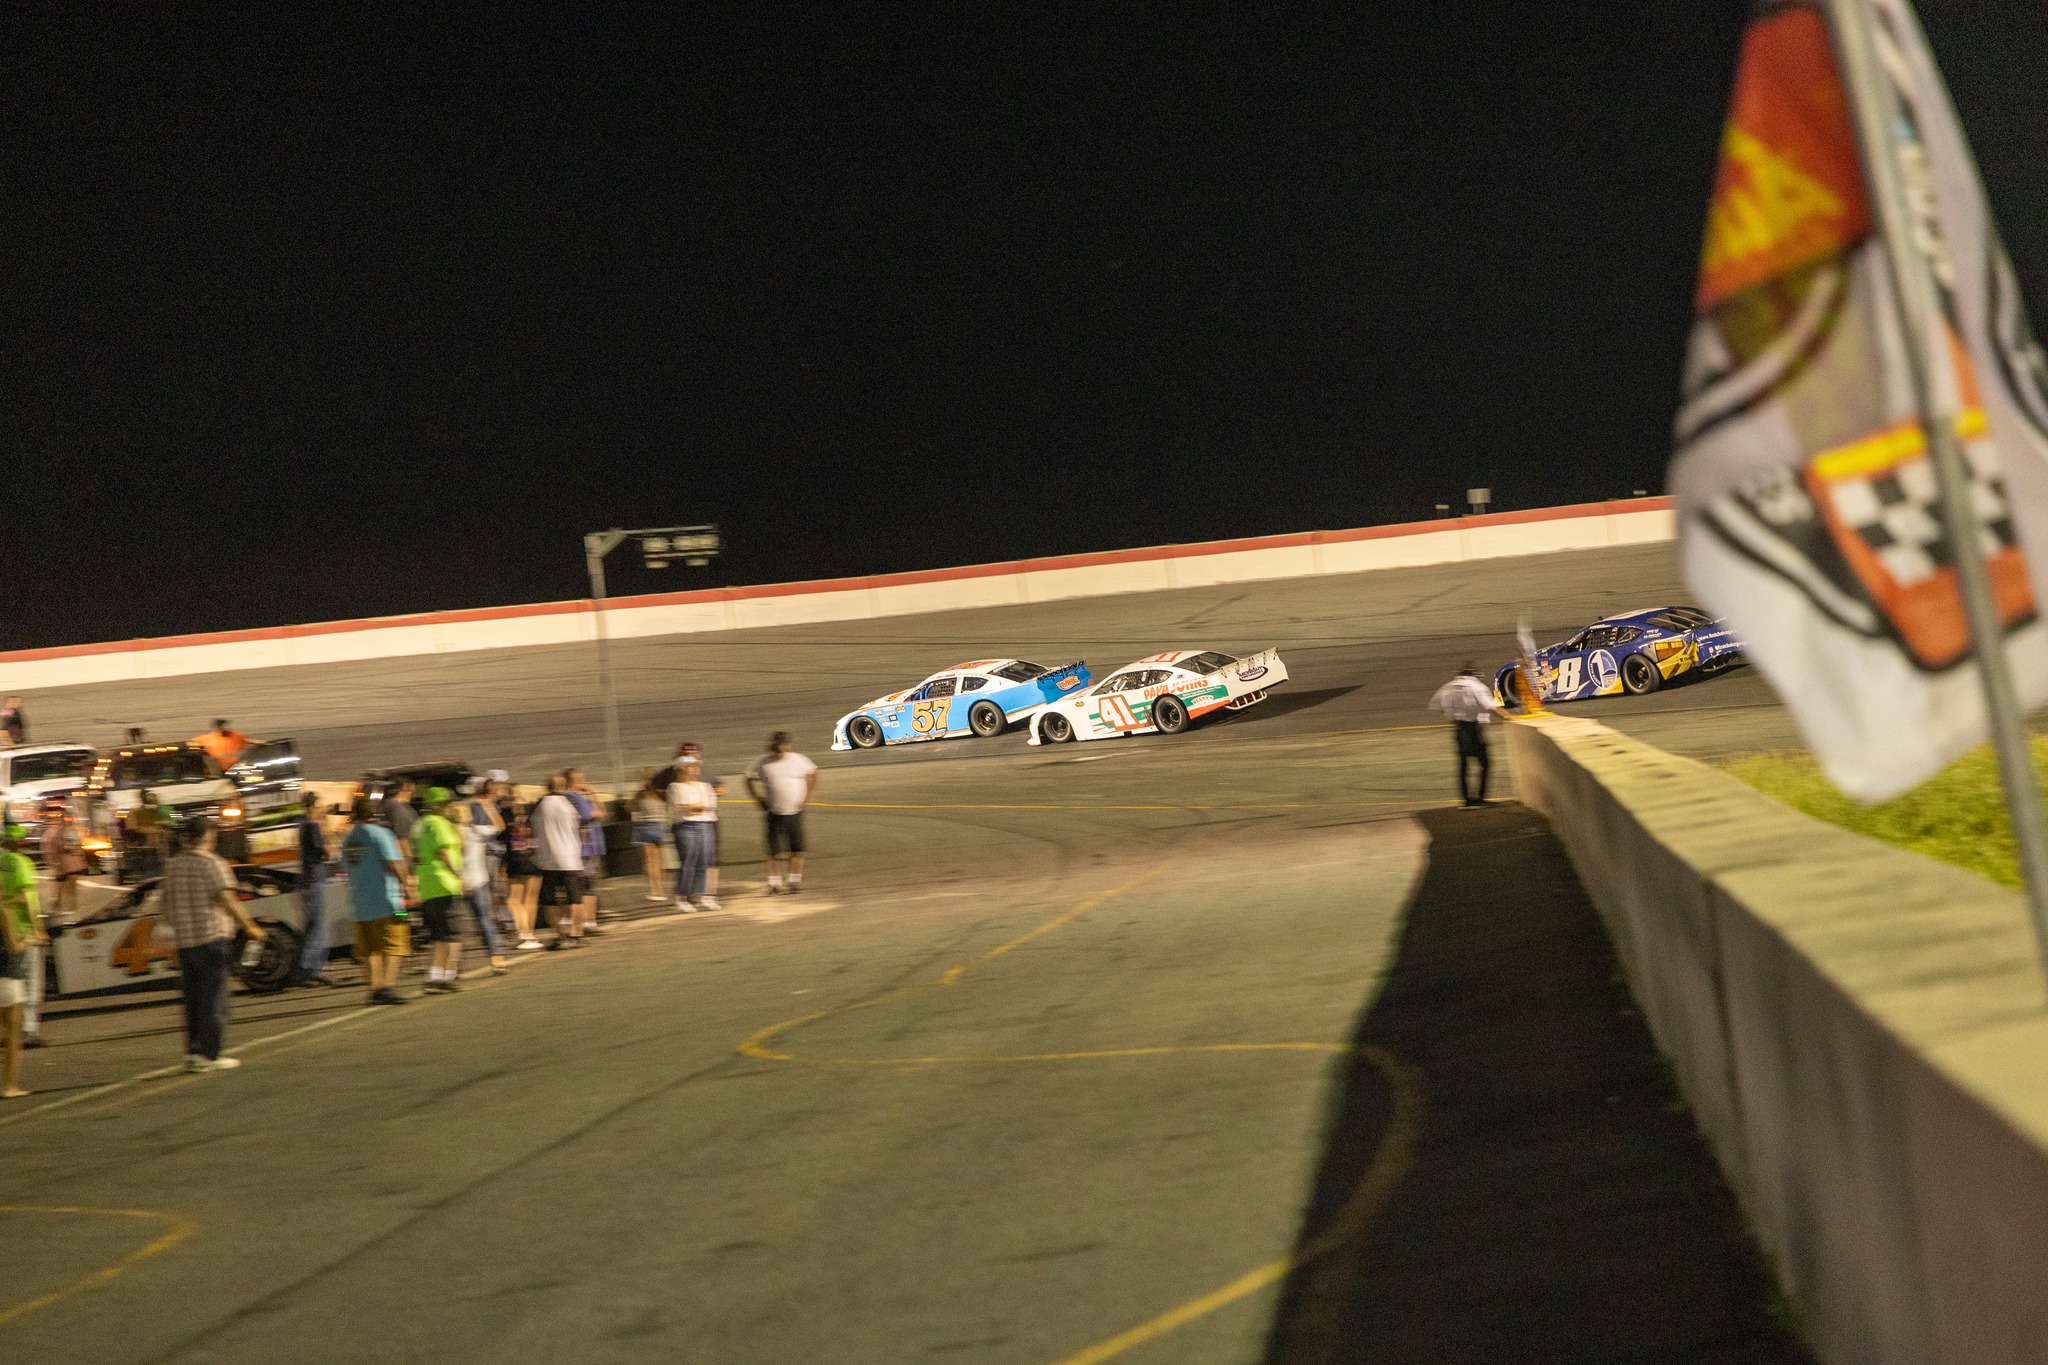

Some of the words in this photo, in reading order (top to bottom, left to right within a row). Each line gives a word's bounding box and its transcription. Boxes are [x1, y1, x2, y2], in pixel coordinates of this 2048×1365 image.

[1143, 684, 1169, 701] PAPA
[1557, 656, 1582, 694] 8
[912, 697, 952, 734] 57
[1098, 694, 1140, 732] 41
